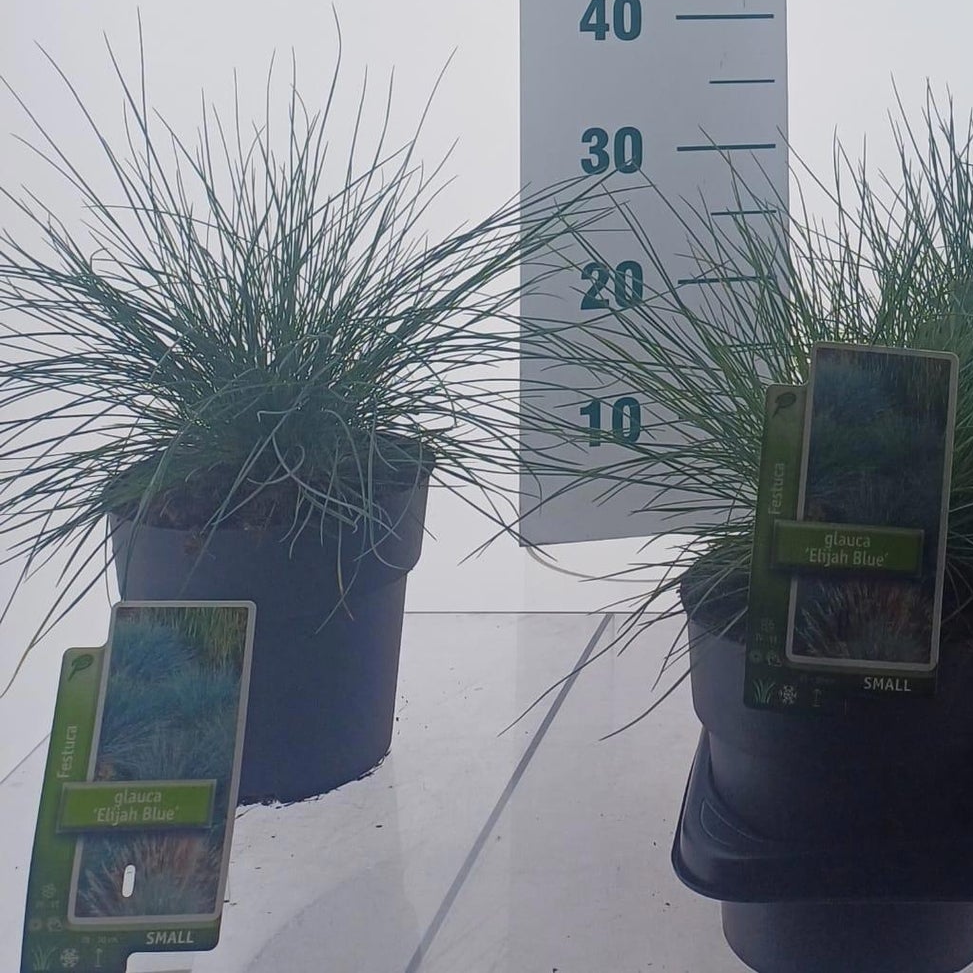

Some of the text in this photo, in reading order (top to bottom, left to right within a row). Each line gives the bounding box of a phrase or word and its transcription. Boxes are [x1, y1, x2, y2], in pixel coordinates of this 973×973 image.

[580, 126, 643, 174] 30
[580, 260, 643, 310] 20
[580, 396, 641, 447] 10
[768, 462, 785, 515] Festuca
[824, 533, 871, 550] glauca
[863, 676, 912, 692] SMALL
[57, 725, 78, 779] Festuca
[114, 788, 162, 808] glauca
[146, 931, 195, 945] SMALL
